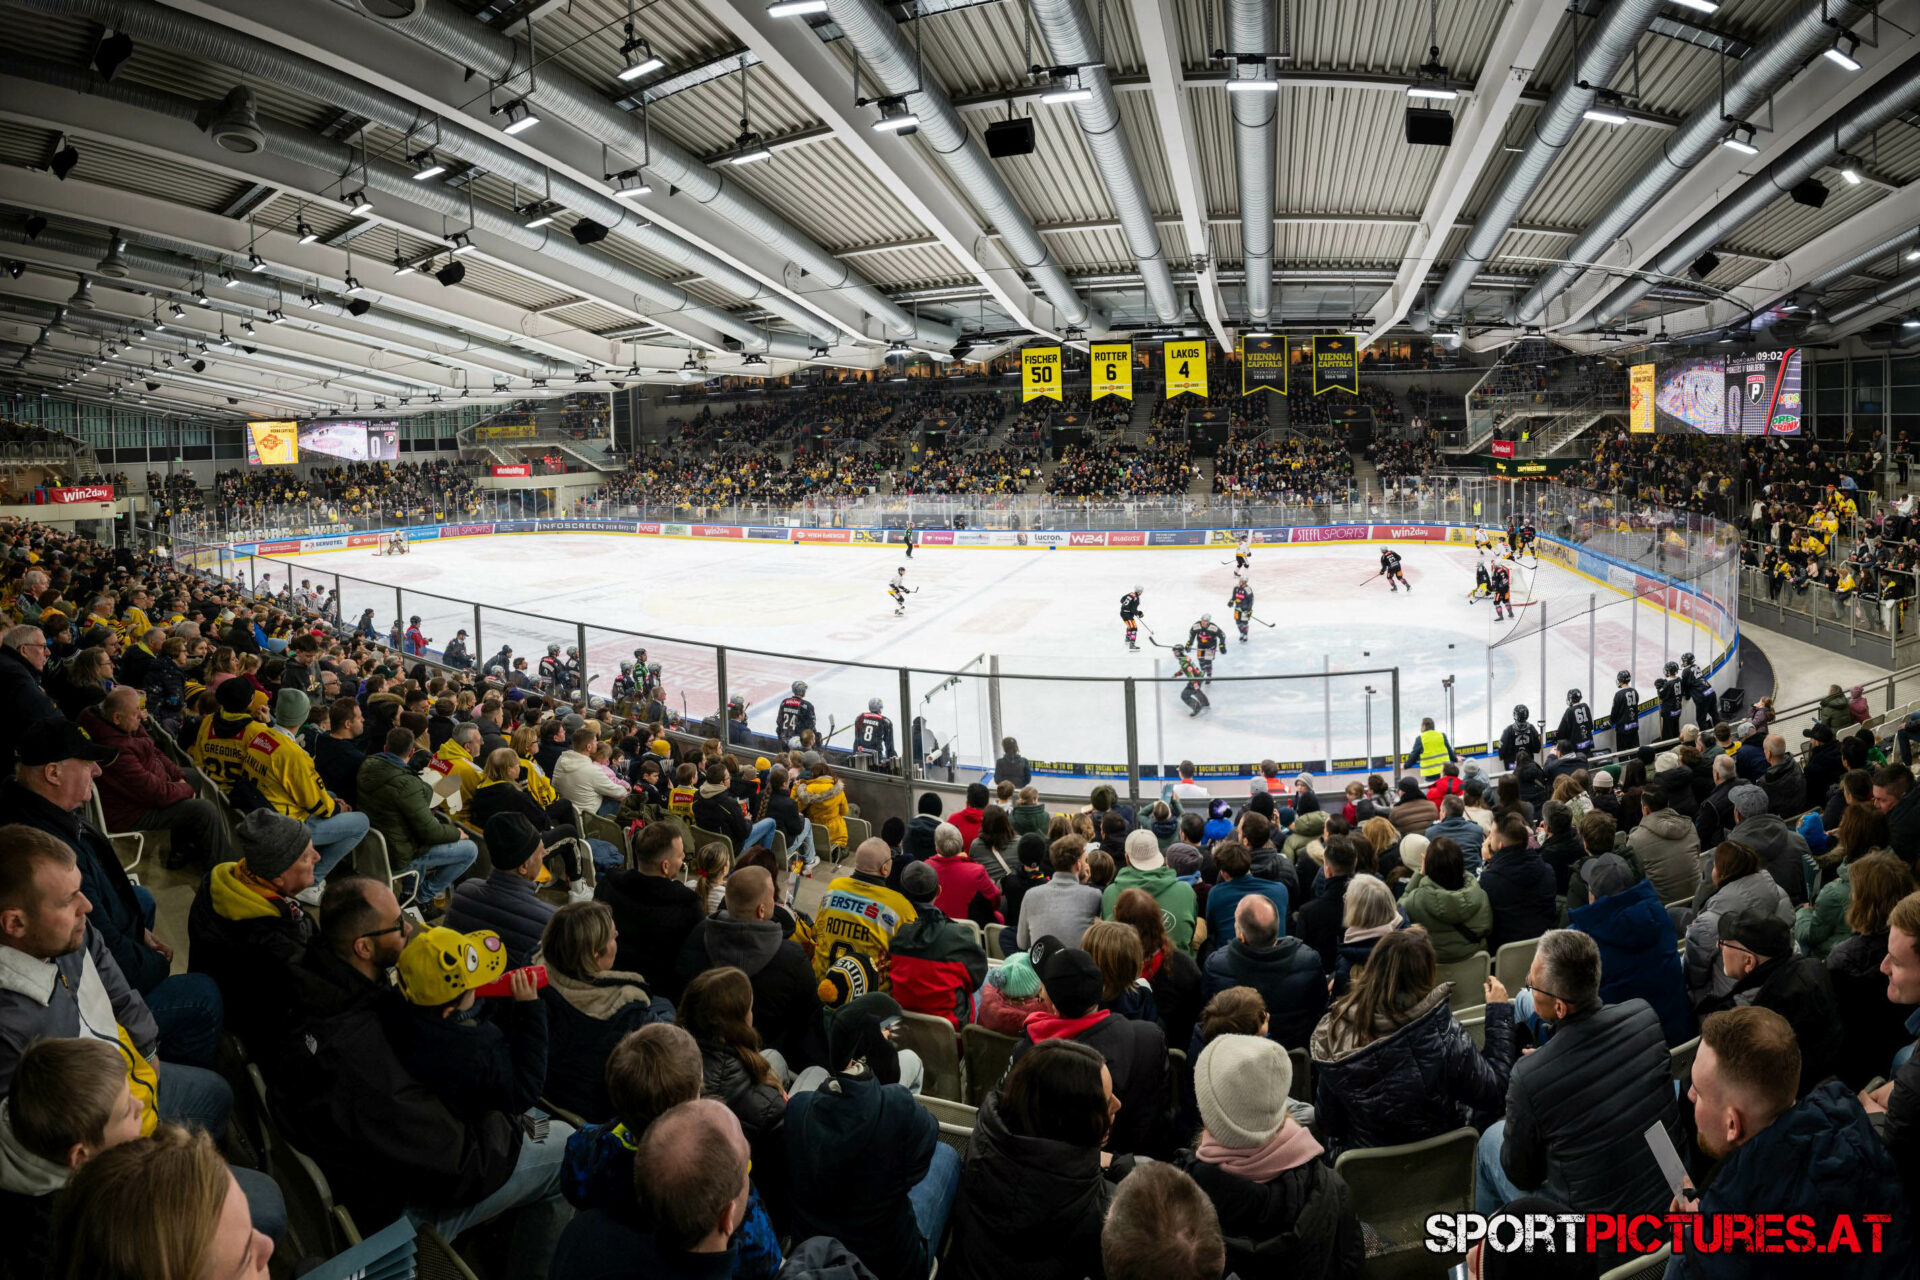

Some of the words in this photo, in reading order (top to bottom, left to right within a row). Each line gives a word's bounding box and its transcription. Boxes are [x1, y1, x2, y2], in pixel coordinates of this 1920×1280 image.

[1024, 354, 1058, 364] FISCHER
[1094, 351, 1128, 361] ROTTER
[1171, 348, 1200, 359] LAKOS
[1247, 353, 1282, 361] VIENNA
[1318, 353, 1352, 361] VIENNA
[1757, 351, 1783, 361] 09:02
[1178, 360, 1190, 378] 4
[1247, 360, 1282, 368] CAPITALS
[1318, 360, 1353, 368] CAPITALS
[1031, 366, 1052, 383] 50
[1106, 363, 1117, 381] 6
[1751, 383, 1760, 400] P
[1779, 393, 1800, 404] KIDS
[1728, 385, 1741, 431] 0
[283, 438, 294, 462] 1
[370, 436, 381, 458] 0
[63, 487, 107, 502] win2day
[461, 525, 491, 535] SPORTS
[538, 522, 604, 530] INFOSCREEN
[1391, 526, 1429, 539] win2day
[1071, 534, 1105, 544] W24
[1297, 527, 1321, 541] STEFFL
[1322, 527, 1365, 540] SPORTS
[1625, 690, 1637, 706] 61
[1574, 706, 1589, 724] 61
[782, 713, 796, 731] 24
[863, 725, 873, 742] 8
[1035, 760, 1051, 769] SOCIAL
[1095, 764, 1113, 772] SOCIAL
[1199, 764, 1216, 772] SOCIAL
[1218, 764, 1231, 772] WITH
[1281, 762, 1294, 770] WITH
[830, 895, 866, 915] ERSTE
[826, 916, 870, 942] ROTTER
[834, 959, 865, 1000] RUINS
